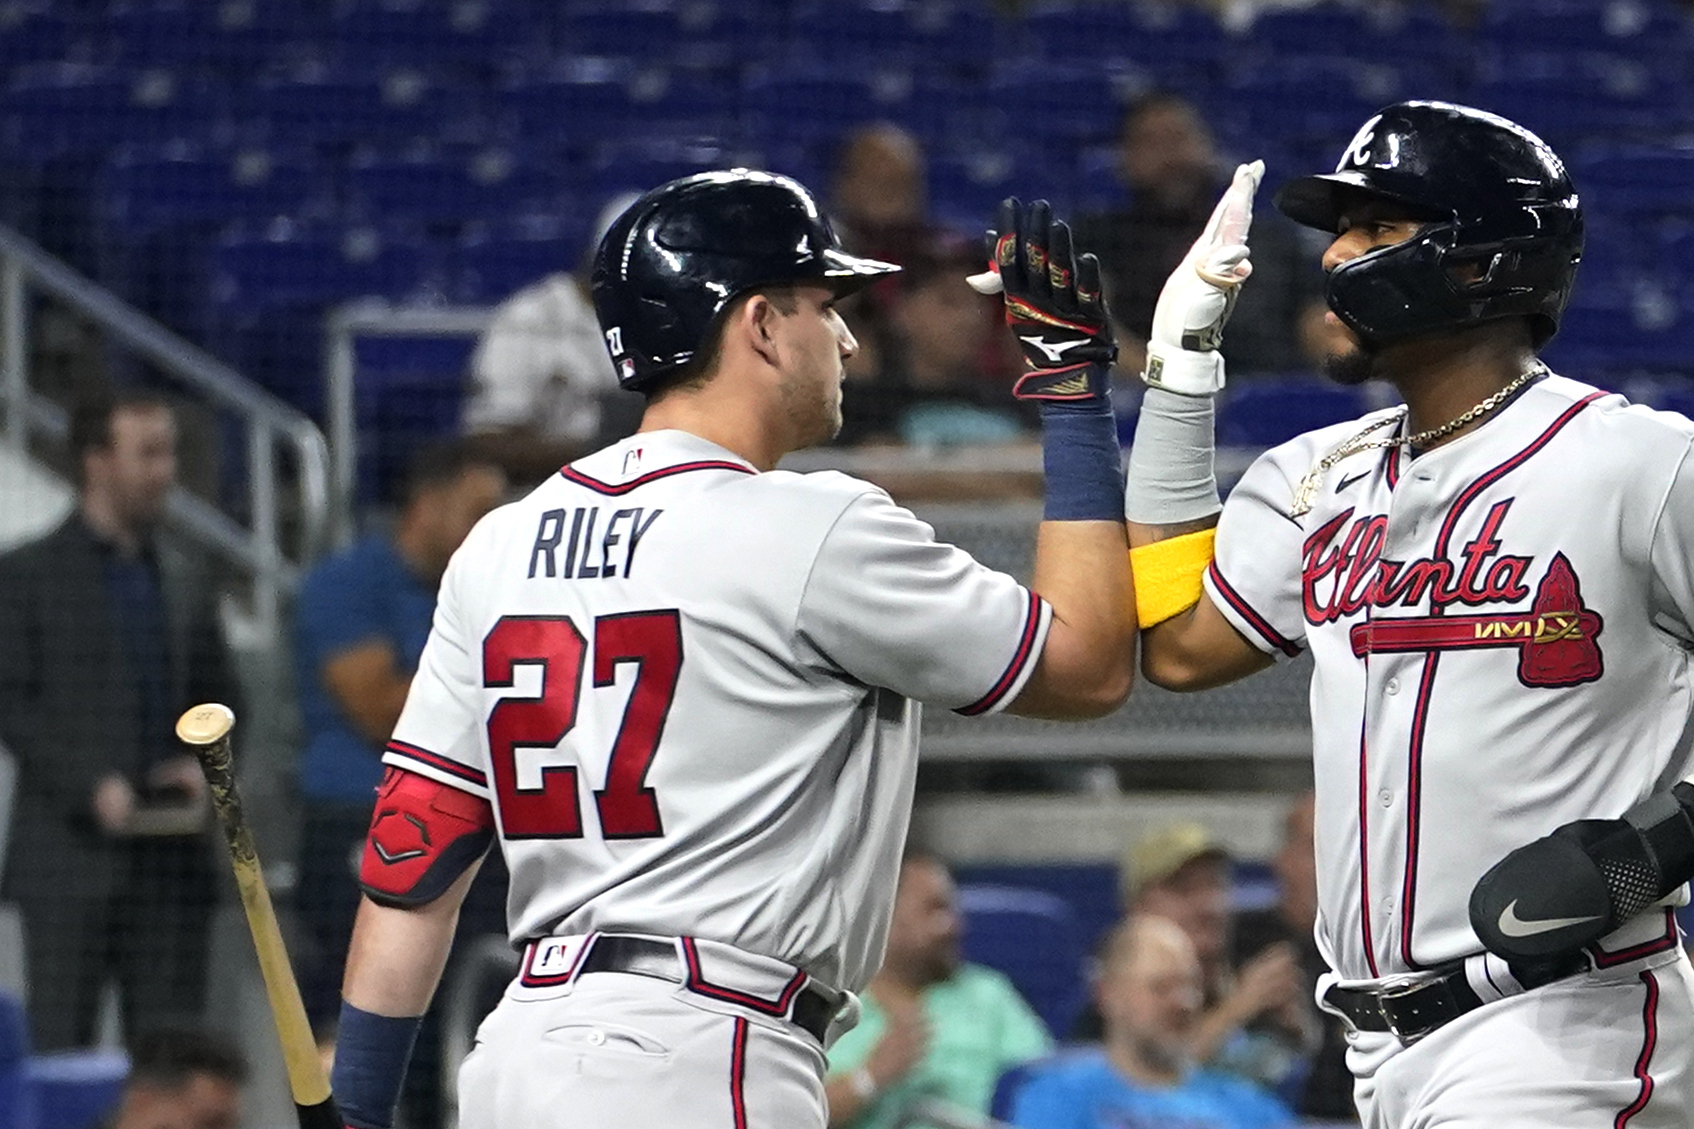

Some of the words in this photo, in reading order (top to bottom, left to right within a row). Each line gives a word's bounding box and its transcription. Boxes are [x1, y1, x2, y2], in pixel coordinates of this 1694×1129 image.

[527, 506, 664, 579] RILEY
[1301, 496, 1535, 627] Atlanta
[482, 608, 685, 841] 27
